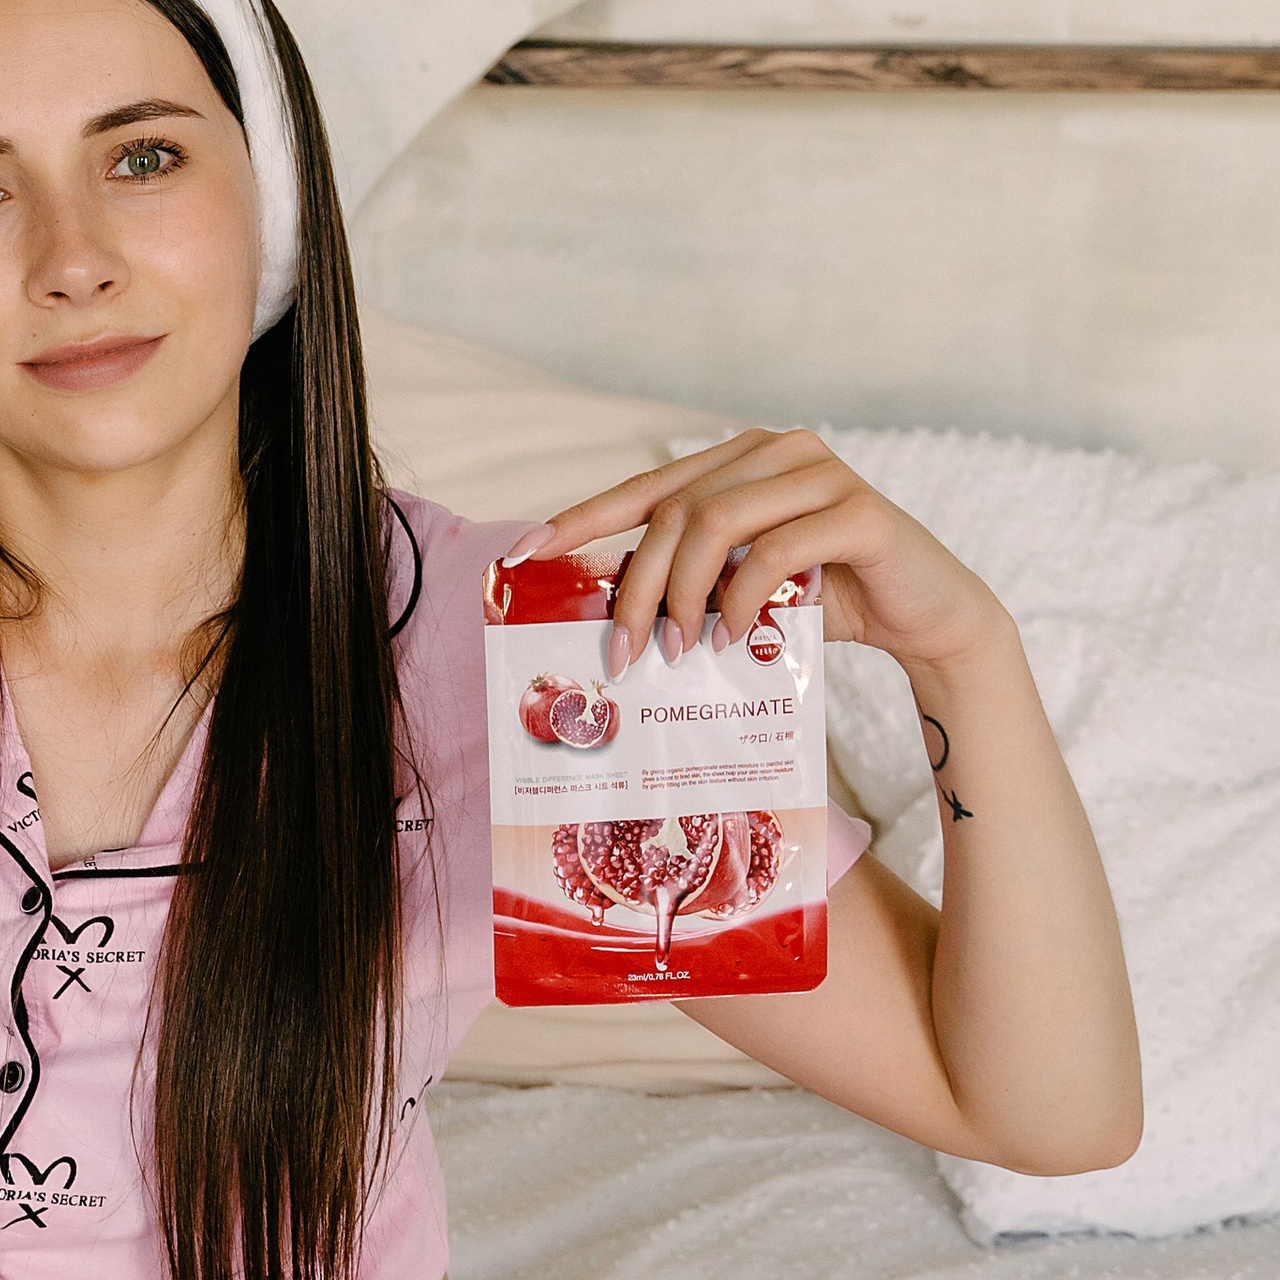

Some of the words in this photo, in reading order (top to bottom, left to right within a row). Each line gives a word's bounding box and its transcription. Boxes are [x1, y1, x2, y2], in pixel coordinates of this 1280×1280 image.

[641, 698, 794, 724] POMEGRANATE
[542, 775, 581, 783] DIFFERENCE
[606, 771, 628, 779] SHEET
[570, 783, 592, 792] 마스크
[594, 782, 608, 790] 시트
[611, 780, 628, 790] 석류]
[86, 951, 146, 963] SECRET
[627, 972, 664, 982] 23ml/0.78
[51, 1193, 107, 1207] SECRET
